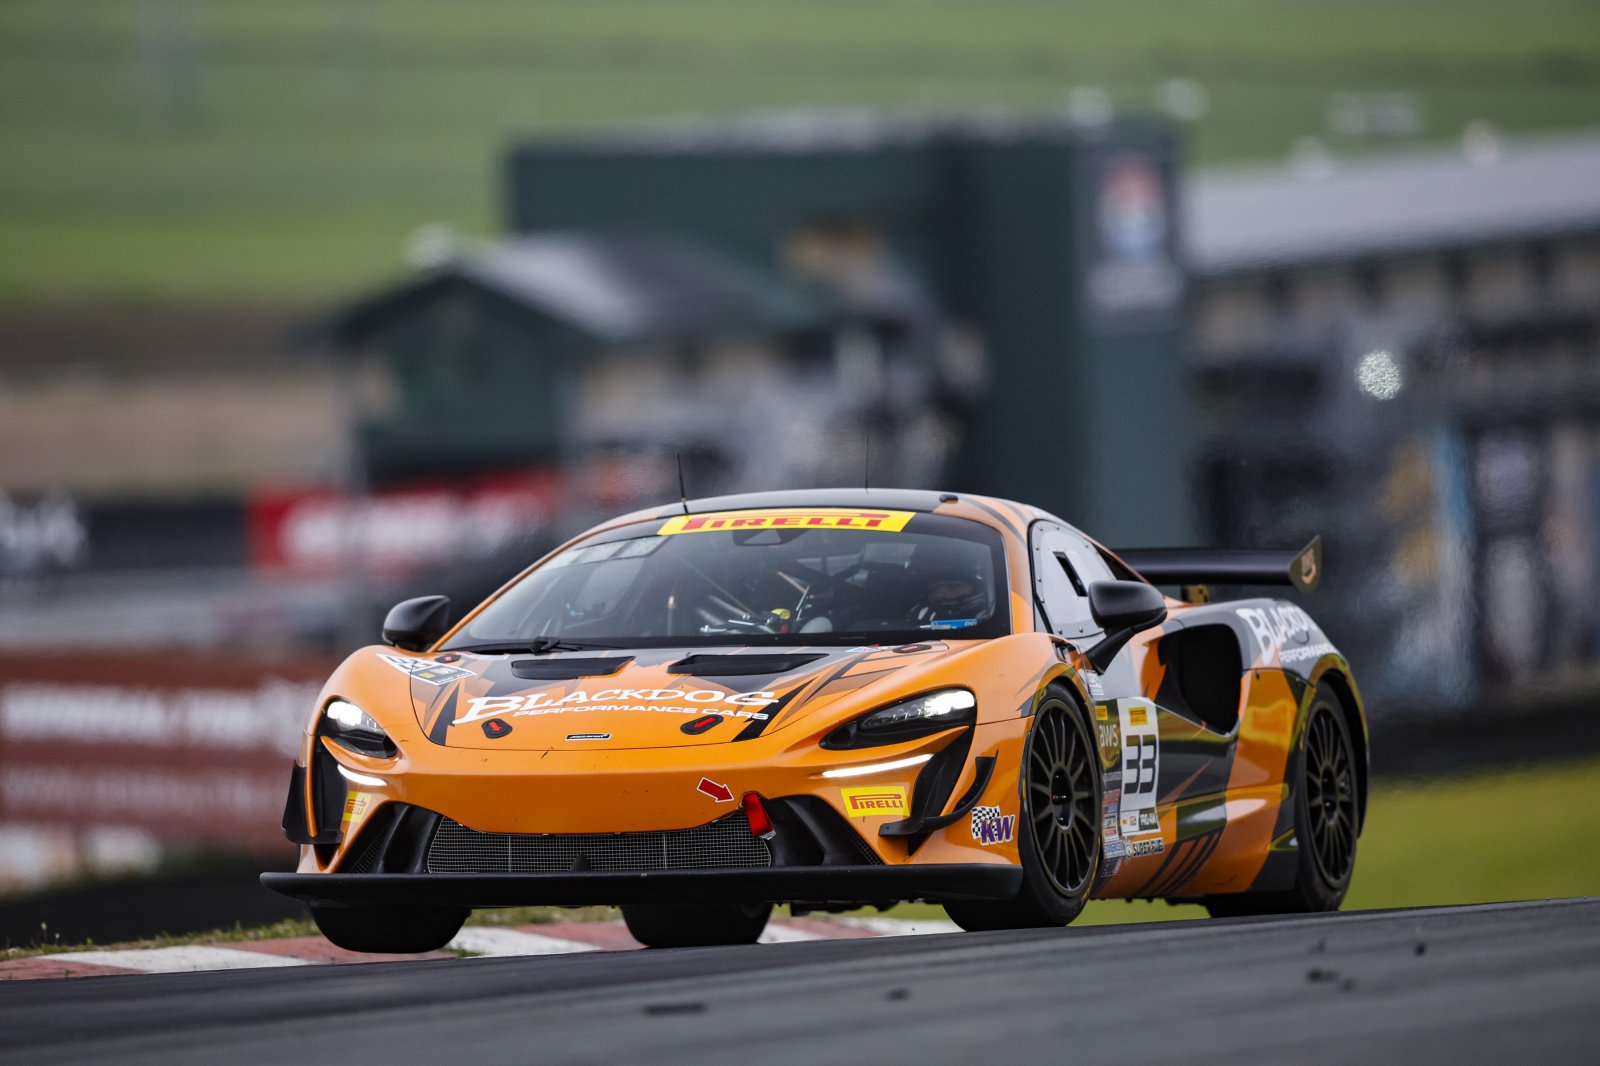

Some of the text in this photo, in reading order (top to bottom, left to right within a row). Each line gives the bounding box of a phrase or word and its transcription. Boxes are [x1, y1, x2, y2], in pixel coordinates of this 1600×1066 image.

[682, 511, 891, 531] PIRELLI
[451, 688, 779, 725] BLACKDOG
[512, 703, 770, 721] PERFORMANCE CARS
[1123, 734, 1158, 795] 33
[849, 793, 904, 810] PIRELLI
[980, 814, 1015, 846] KW
